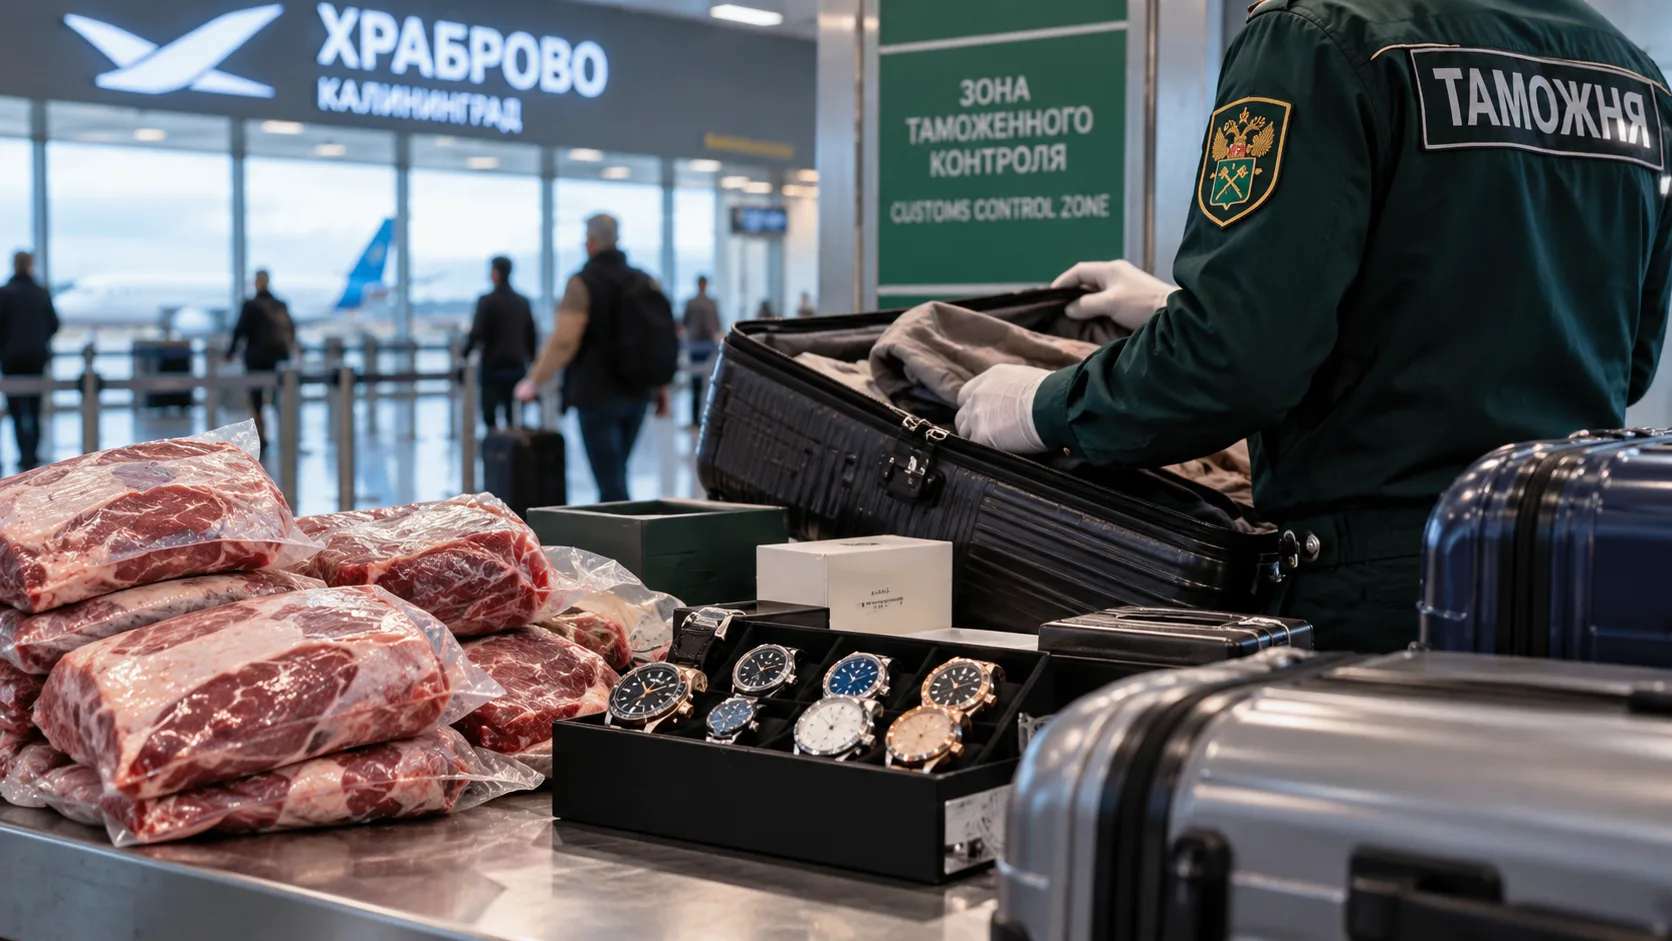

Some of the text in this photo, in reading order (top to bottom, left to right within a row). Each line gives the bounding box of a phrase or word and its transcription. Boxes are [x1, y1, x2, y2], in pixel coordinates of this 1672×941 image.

[316, 2, 608, 98] ХРАБРОВО
[317, 76, 523, 134] КАЛИНИНГРАД
[959, 75, 1031, 107] ЗОНА
[1432, 67, 1651, 149] ТАМОЖНЯ
[906, 105, 1094, 145] ТАМОЖЕННОГО
[930, 143, 1067, 178] КОНТРОЛЯ
[890, 194, 1110, 224] CUSTOMS CONTROL ZONE
